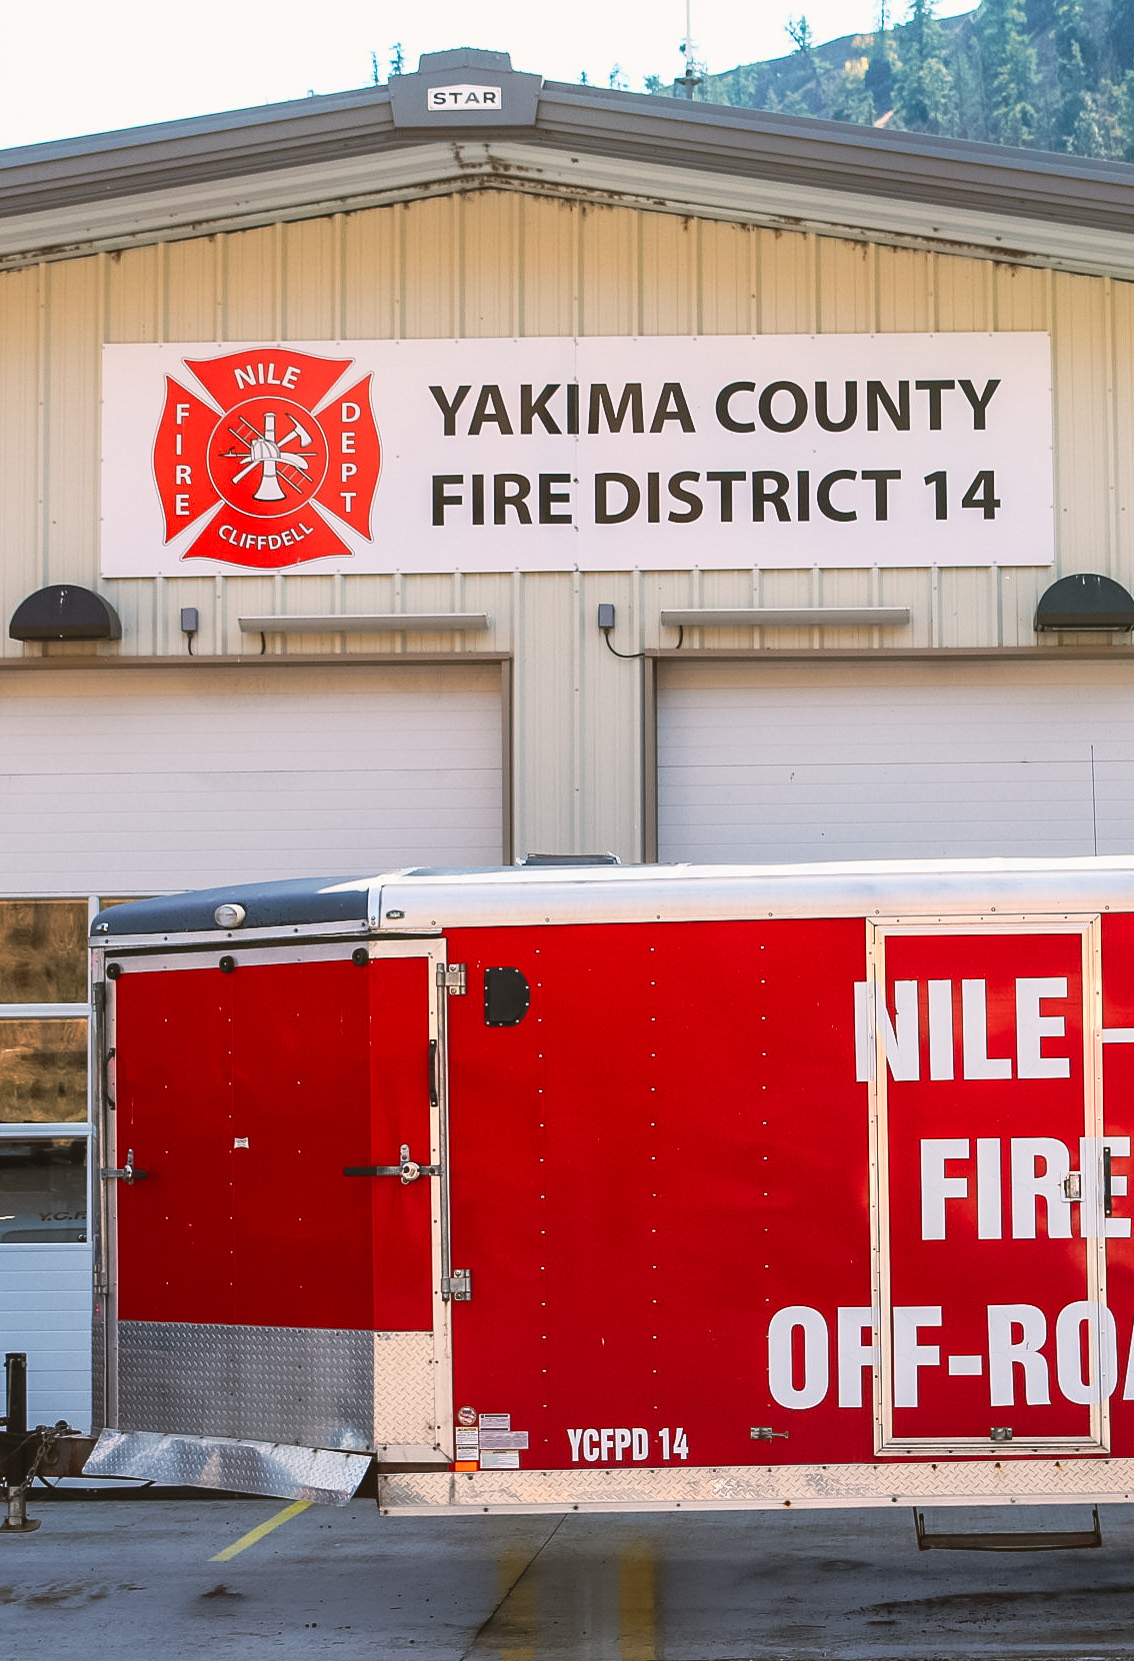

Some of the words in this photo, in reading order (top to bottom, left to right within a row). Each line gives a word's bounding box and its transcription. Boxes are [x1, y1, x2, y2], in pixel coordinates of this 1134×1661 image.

[433, 91, 497, 106] STAR
[233, 362, 301, 390] NILE
[428, 382, 697, 436] YAKIMA
[715, 379, 1001, 433] COUNTY
[174, 402, 193, 516] FIRE
[339, 401, 362, 513] DEPT
[431, 473, 573, 526] FIRE
[594, 469, 901, 524] DISTRICT
[923, 470, 1001, 521] 14
[217, 522, 315, 551] CLIFFDELL
[853, 977, 1071, 1082] NILE
[920, 1136, 1131, 1241] FIRE
[567, 1427, 650, 1462] YCFPD
[658, 1427, 690, 1460] 14
